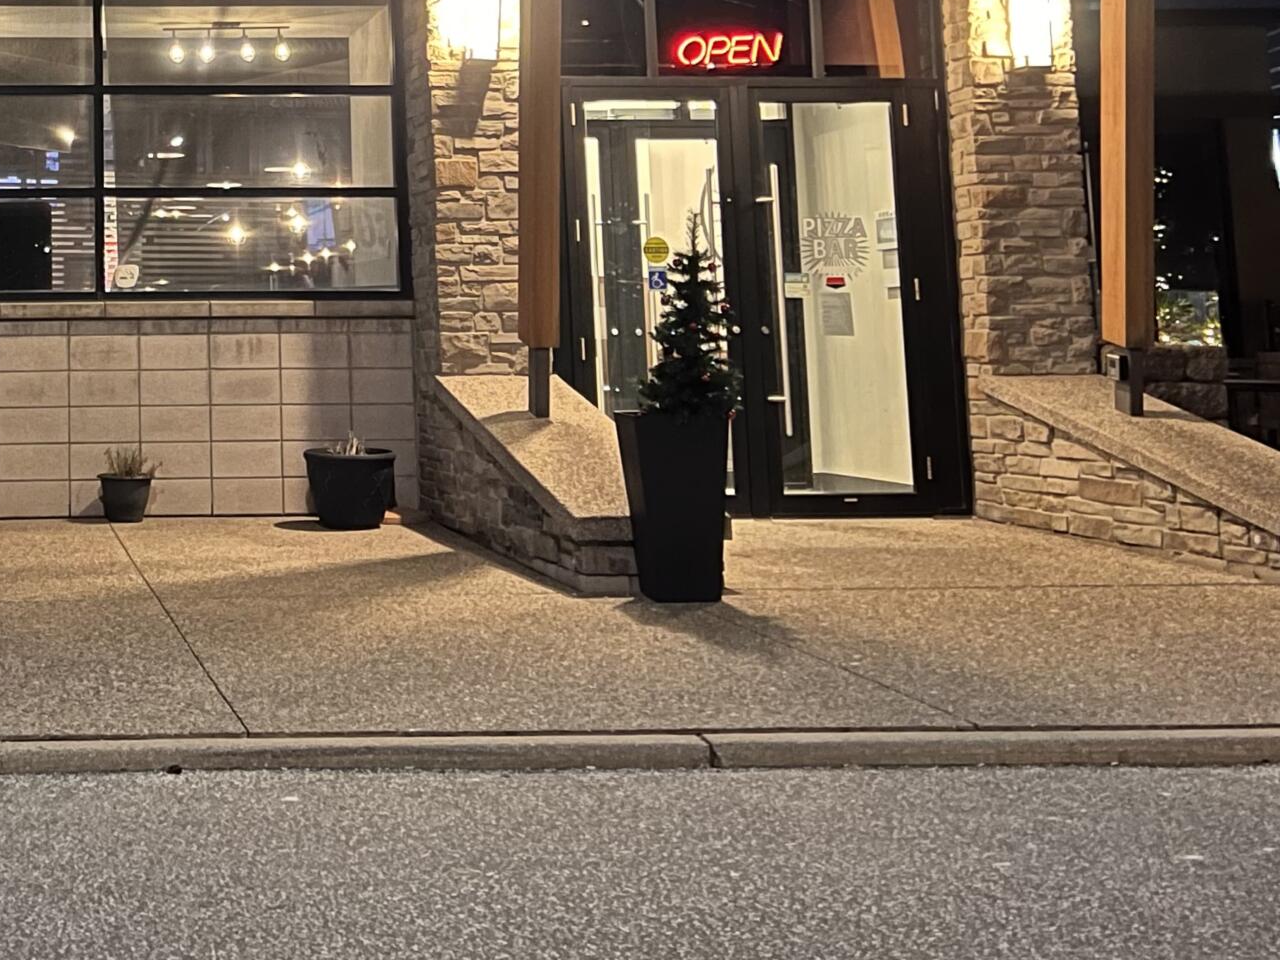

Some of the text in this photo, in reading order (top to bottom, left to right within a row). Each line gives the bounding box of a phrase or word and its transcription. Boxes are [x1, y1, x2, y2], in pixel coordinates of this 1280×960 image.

[677, 32, 783, 65] OPEN
[802, 216, 867, 238] PIZZA
[813, 239, 859, 259] BAR
